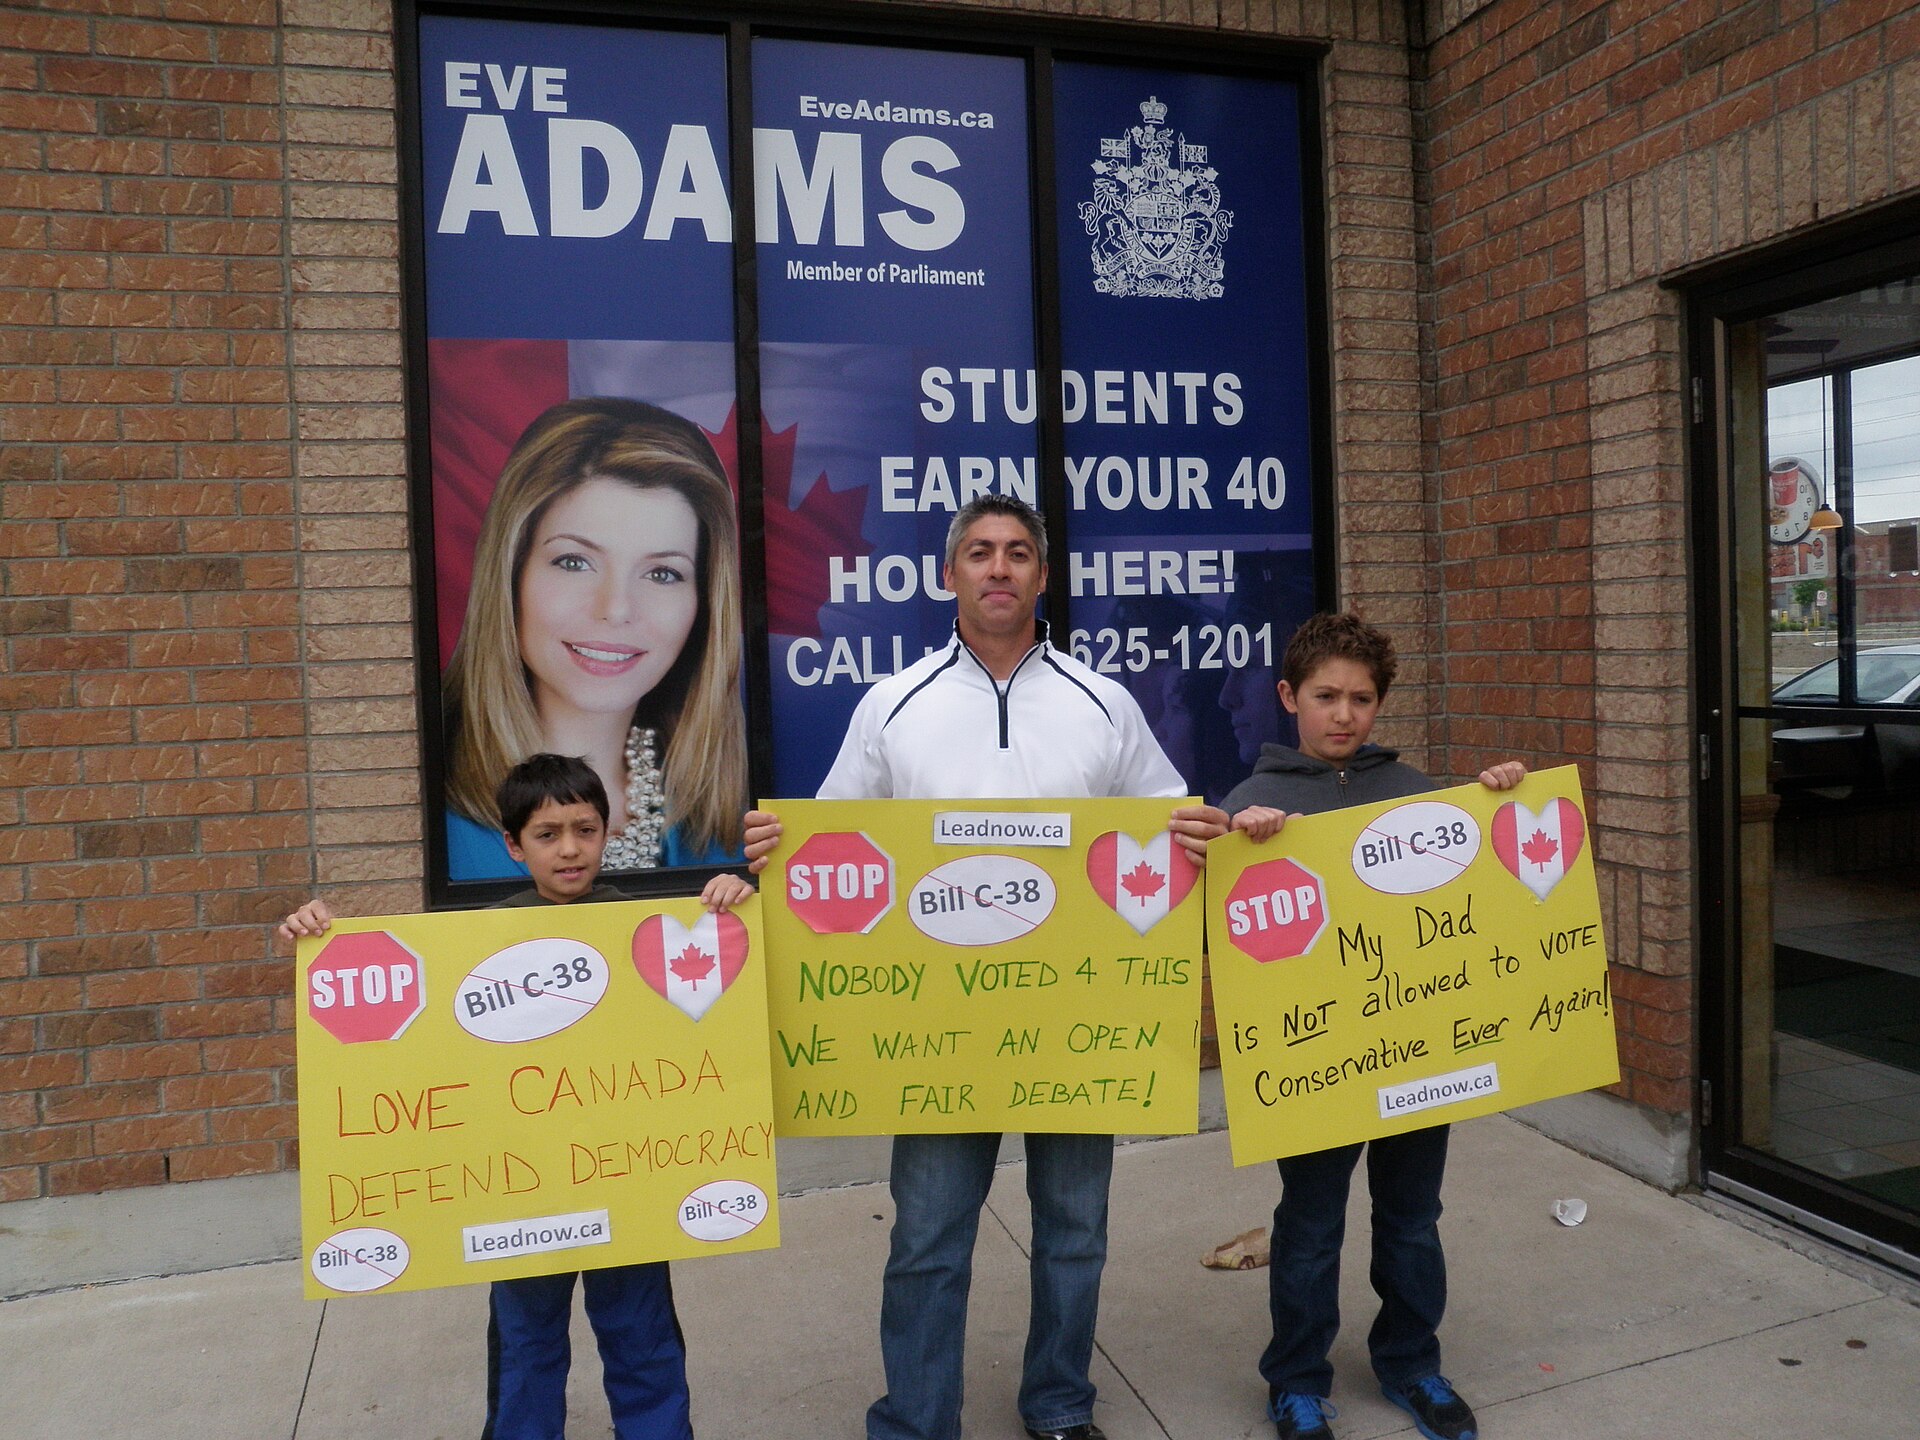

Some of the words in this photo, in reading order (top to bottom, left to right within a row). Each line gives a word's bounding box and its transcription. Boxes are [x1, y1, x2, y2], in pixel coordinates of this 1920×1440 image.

[445, 62, 567, 112] EVE
[800, 96, 994, 129] EveAdams.ca
[437, 114, 965, 251] ADAMS
[787, 260, 863, 282] Member
[866, 262, 886, 282] of
[889, 263, 985, 286] Parliament
[920, 367, 1243, 426] STUDENTS
[881, 457, 1036, 512] EARN
[1064, 456, 1210, 510] YOUR
[1227, 457, 1285, 510] 40
[829, 555, 957, 602] HOU
[1070, 550, 1234, 596] HERE!
[940, 818, 1064, 840] Leadnow.ca
[1361, 836, 1403, 868] Bill
[1409, 822, 1468, 856] C-38
[790, 863, 884, 900] STOP
[919, 885, 965, 915] Bill
[973, 879, 1041, 910] C-38
[1228, 885, 1317, 937] STOP
[1338, 923, 1383, 981] My
[1414, 893, 1477, 949] Dad
[311, 963, 414, 1009] STOP
[465, 979, 516, 1018] Bill
[522, 956, 593, 999] C-38
[799, 960, 926, 1002] NOBODY
[955, 959, 1059, 996] VOTED
[1075, 957, 1098, 985] 4
[1116, 957, 1191, 986] THIS
[1233, 1022, 1259, 1054] is
[1283, 1000, 1337, 1039] NOT
[1362, 960, 1472, 1019] allowed
[1489, 945, 1520, 978] to
[1540, 924, 1597, 960] VOTE
[777, 1024, 837, 1068] WE
[872, 1031, 972, 1060] WANT
[996, 1028, 1041, 1057] AN
[1067, 1022, 1161, 1054] OPEN
[1254, 1037, 1429, 1107] Conservative
[1453, 1016, 1509, 1050] Ever
[1529, 970, 1611, 1032] Again!
[338, 1083, 470, 1138] LOVE
[509, 1049, 725, 1116] CANADA
[794, 1090, 858, 1120] AND
[900, 1084, 976, 1116] FAIR
[1008, 1071, 1156, 1109] DEBATE!
[1385, 1074, 1493, 1111] Leadnow.ca
[328, 1152, 541, 1225] DEFEND
[570, 1121, 774, 1185] DEMOCRACY
[685, 1200, 713, 1221] Bill
[717, 1194, 757, 1216] C-38
[318, 1247, 349, 1270] Bill
[355, 1244, 398, 1264] C-38
[471, 1220, 604, 1254] Leadnow.ca
